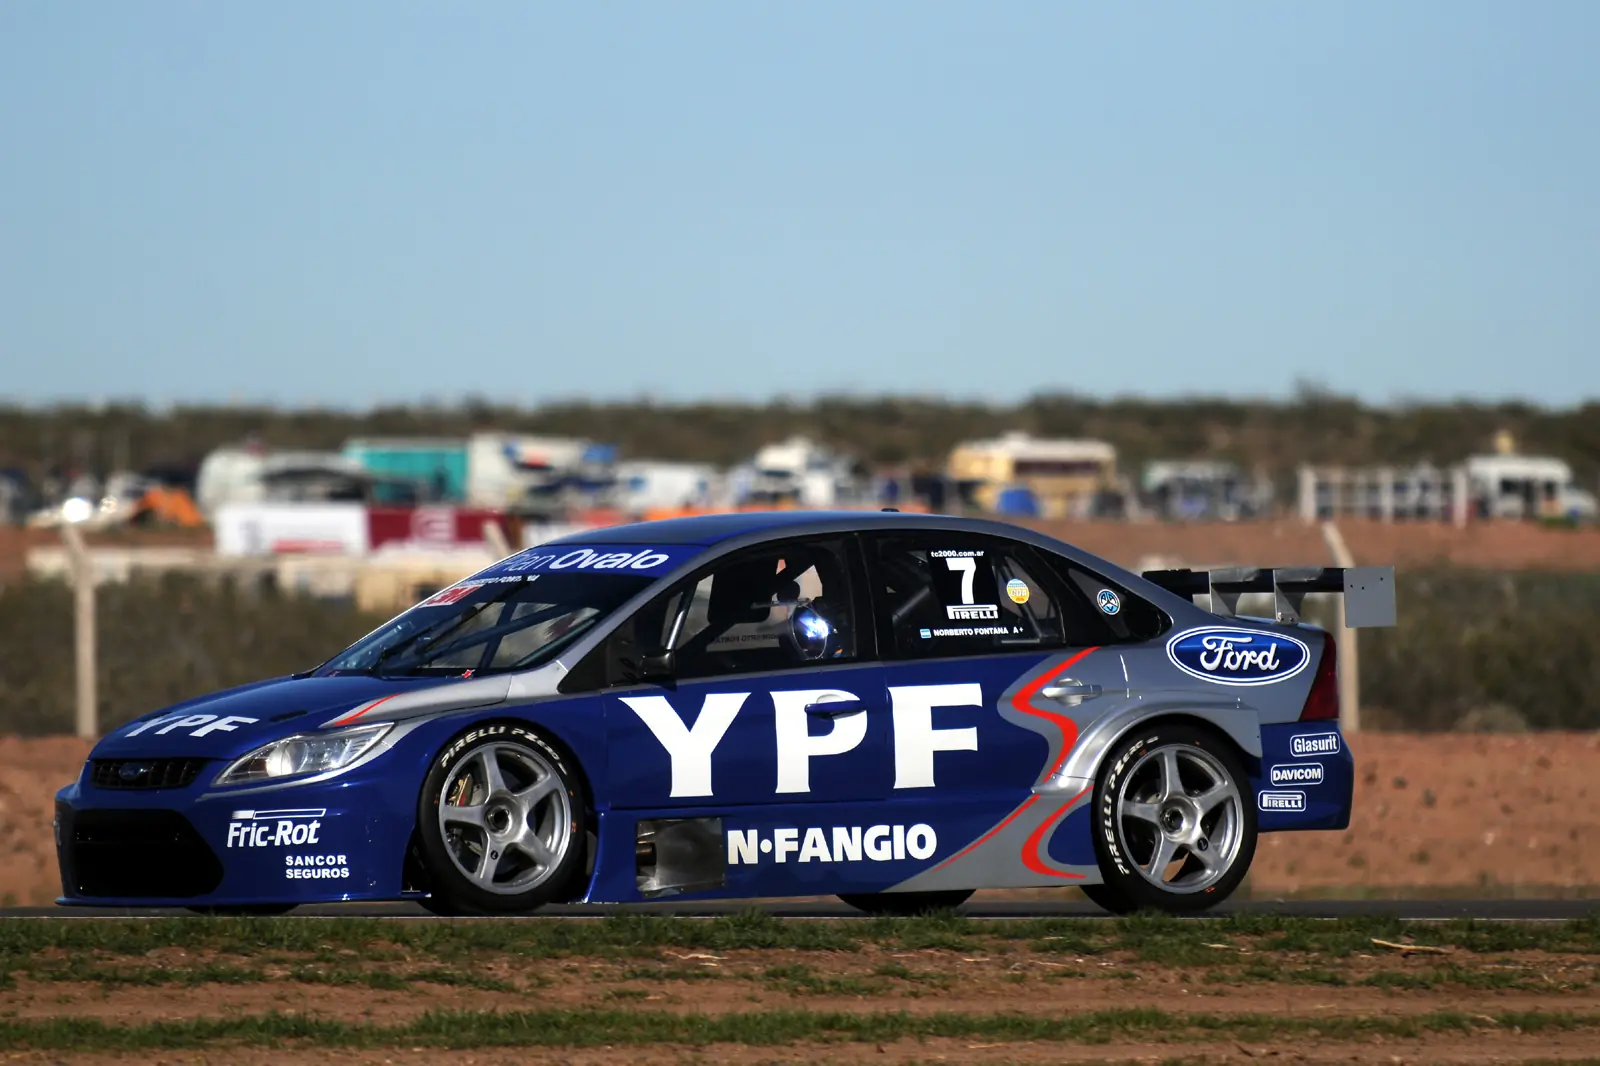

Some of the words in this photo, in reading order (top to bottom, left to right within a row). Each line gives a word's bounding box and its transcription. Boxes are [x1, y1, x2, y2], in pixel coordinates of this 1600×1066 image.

[549, 548, 670, 570] Ovalo
[930, 550, 985, 558] tc2000.com.ar
[945, 557, 977, 605] 7
[946, 604, 999, 620] PIRELLI
[933, 628, 974, 637] NORBERTO
[974, 626, 1009, 636] FONTANA
[1199, 635, 1281, 672] Ford
[125, 714, 260, 738] YPF
[440, 725, 506, 769] PIRELLI
[618, 682, 984, 798] YPF
[1293, 735, 1338, 753] Glasurit
[1272, 768, 1322, 781] DAVICOM
[1262, 793, 1303, 808] PIRELLI
[226, 819, 321, 848] Fric-Rot
[1103, 795, 1130, 876] PIRELLI
[285, 854, 348, 867] SANCOR
[285, 867, 350, 880] SEGUROS
